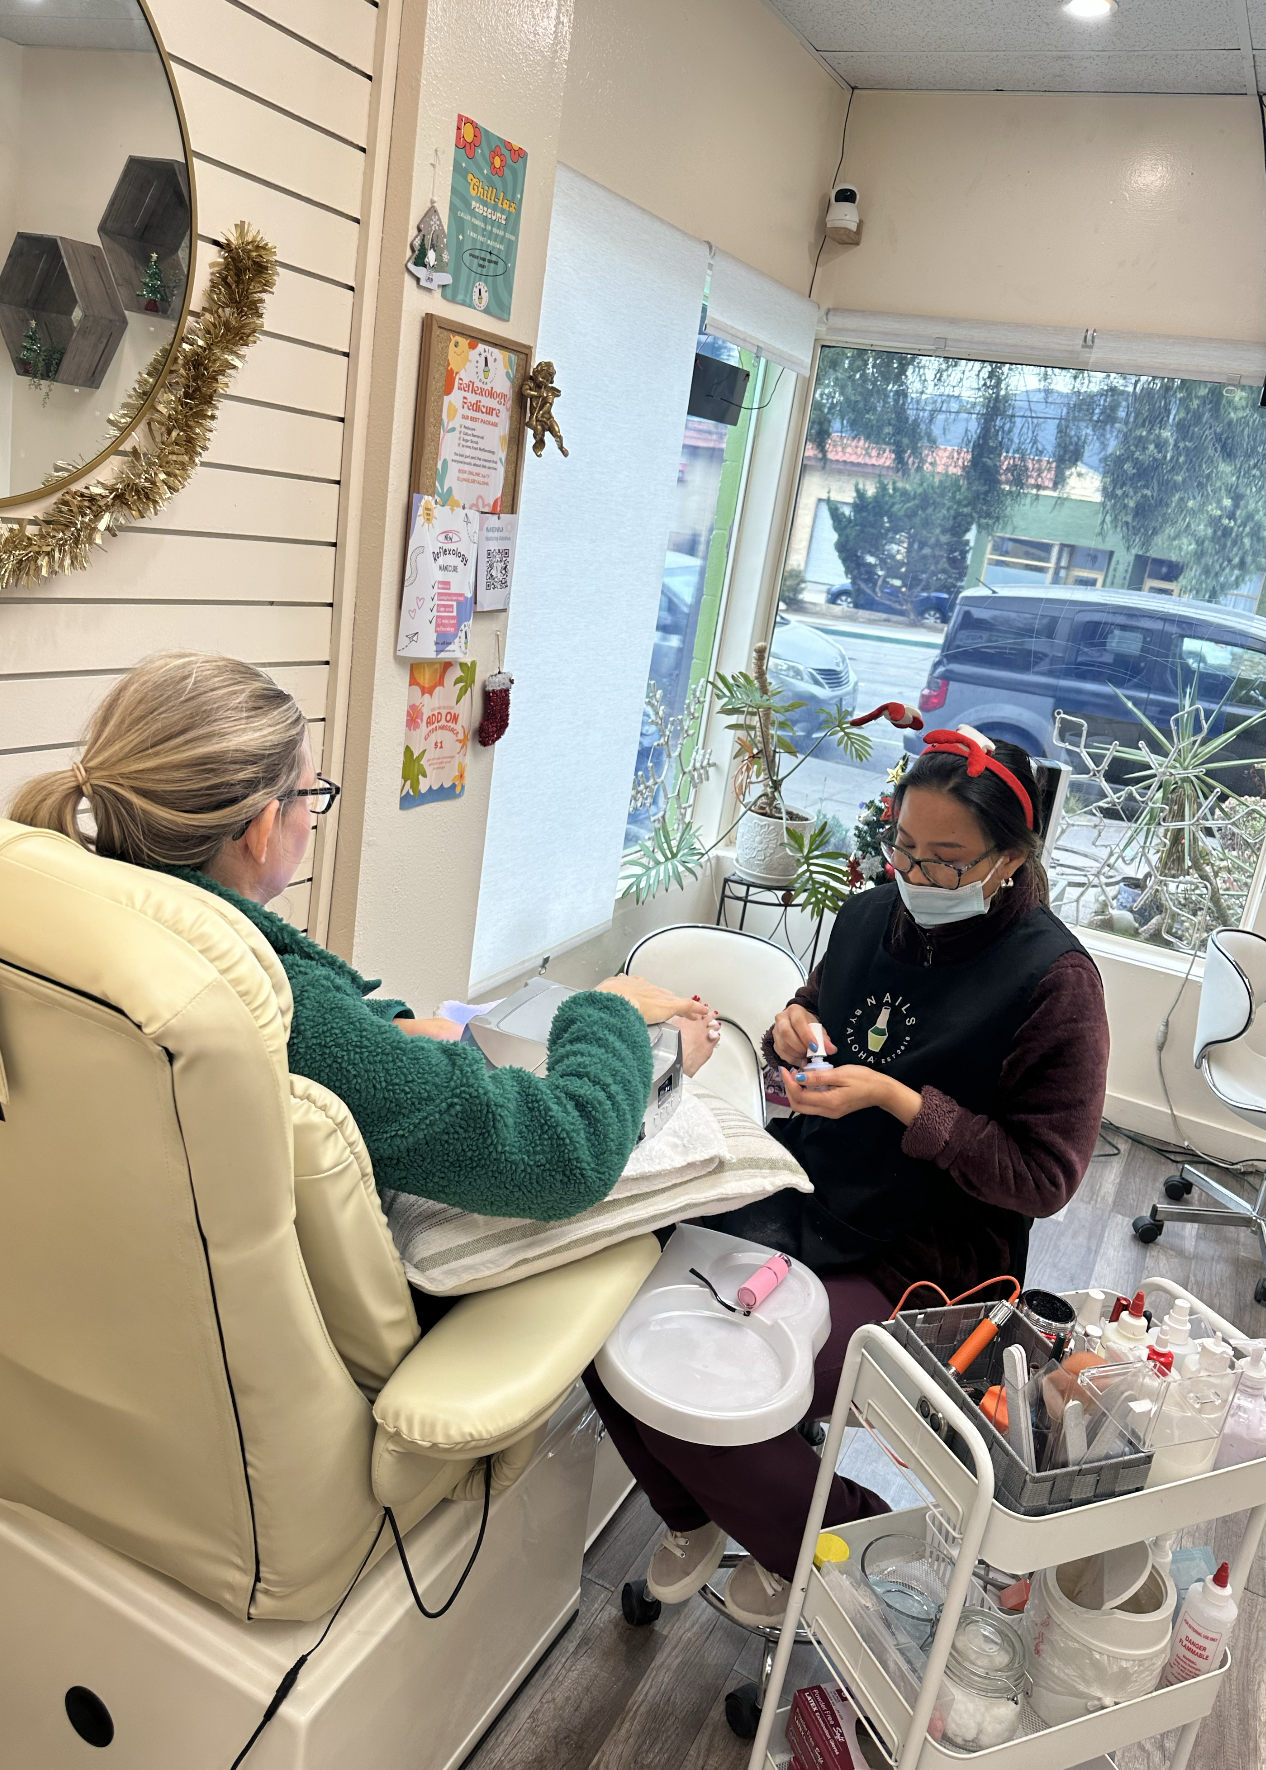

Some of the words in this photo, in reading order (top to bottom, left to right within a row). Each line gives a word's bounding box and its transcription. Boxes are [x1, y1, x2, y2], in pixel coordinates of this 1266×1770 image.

[468, 173, 516, 212] Chill-lax
[472, 200, 507, 225] PEDICURE
[458, 377, 508, 406] Reflexology
[462, 396, 500, 417] Pedicure
[480, 418, 498, 427] PACKAGE
[432, 546, 469, 566] Reflexology
[426, 711, 442, 728] ADD
[445, 711, 459, 725] ON
[434, 740, 444, 750] $1
[850, 1008, 862, 1024] BY
[866, 992, 916, 1026] NAILS
[846, 1027, 875, 1063] ALOHA
[1179, 1638, 1209, 1660] FLAMMABLE
[1185, 1635, 1207, 1652] DANGER
[804, 1692, 818, 1712] LATEX
[812, 1689, 828, 1711] Powder
[824, 1709, 834, 1725] Free
[833, 1726, 845, 1742] Soft
